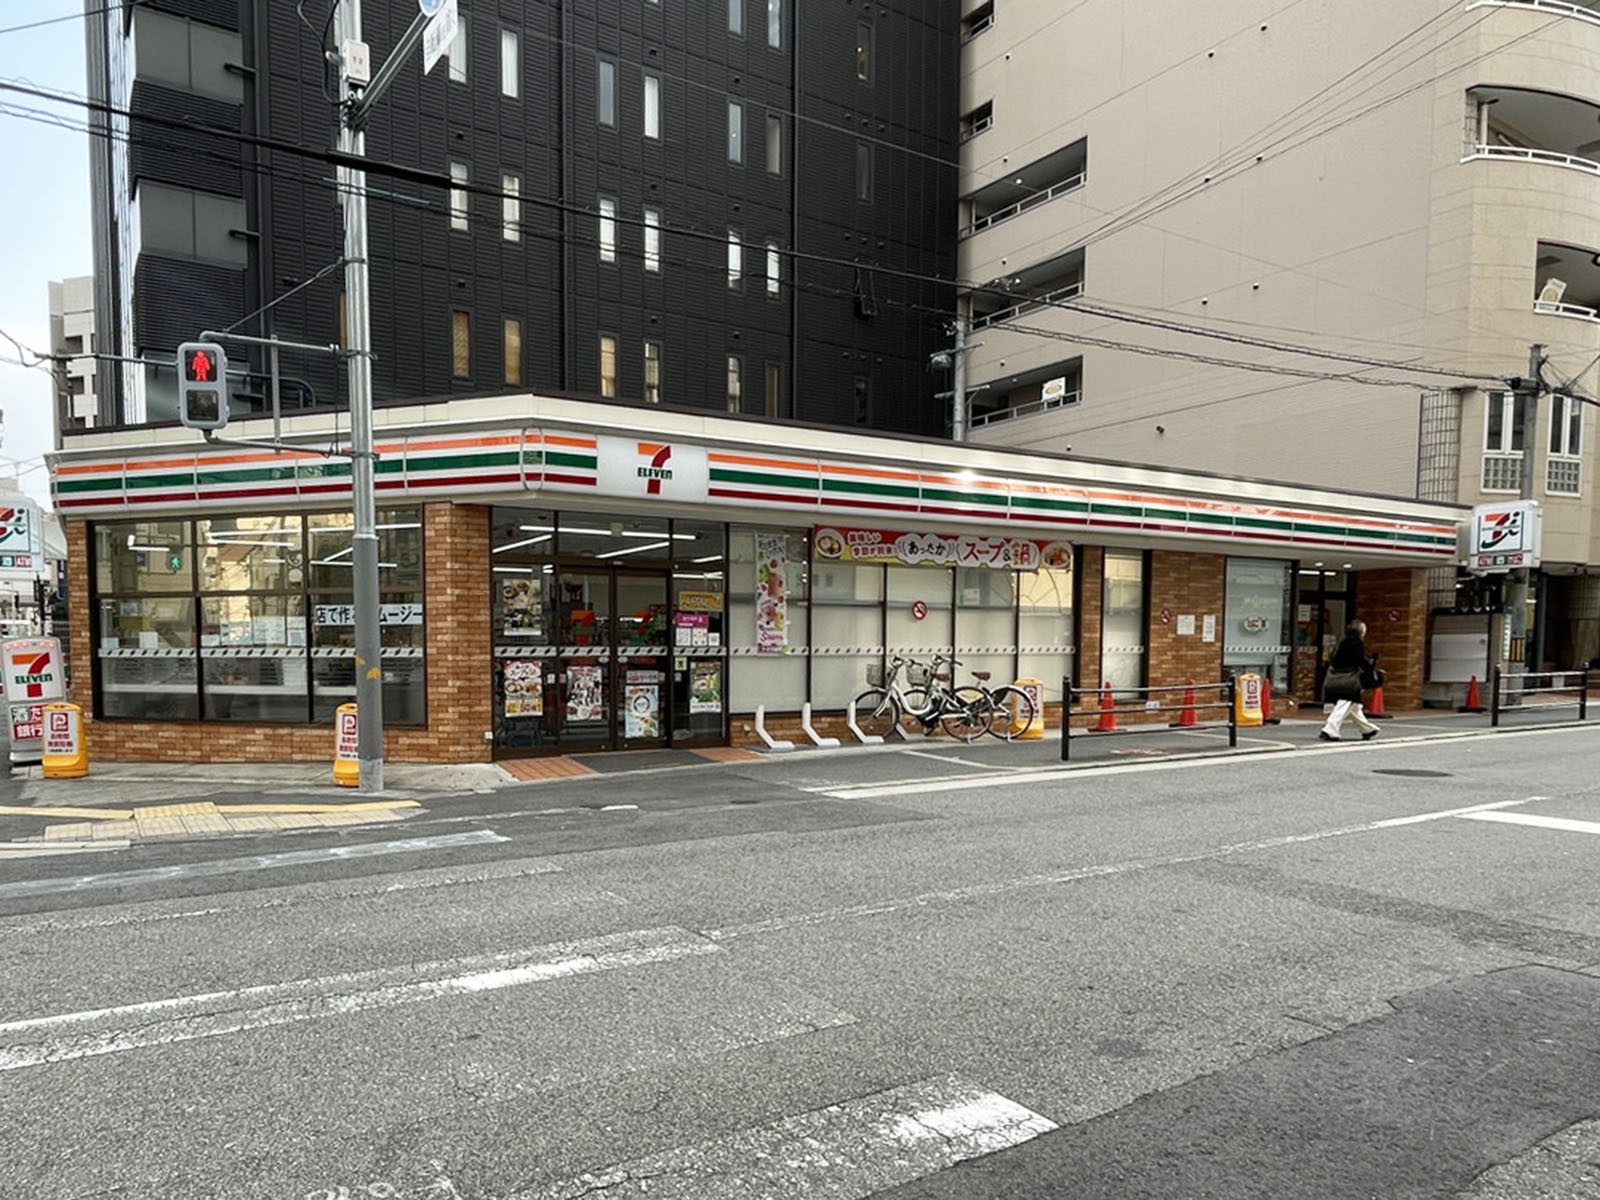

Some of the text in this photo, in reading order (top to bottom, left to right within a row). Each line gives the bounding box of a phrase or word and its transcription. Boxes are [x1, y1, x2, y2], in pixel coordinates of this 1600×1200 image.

[637, 467, 673, 480] ELEVEN
[907, 540, 947, 557] あったか
